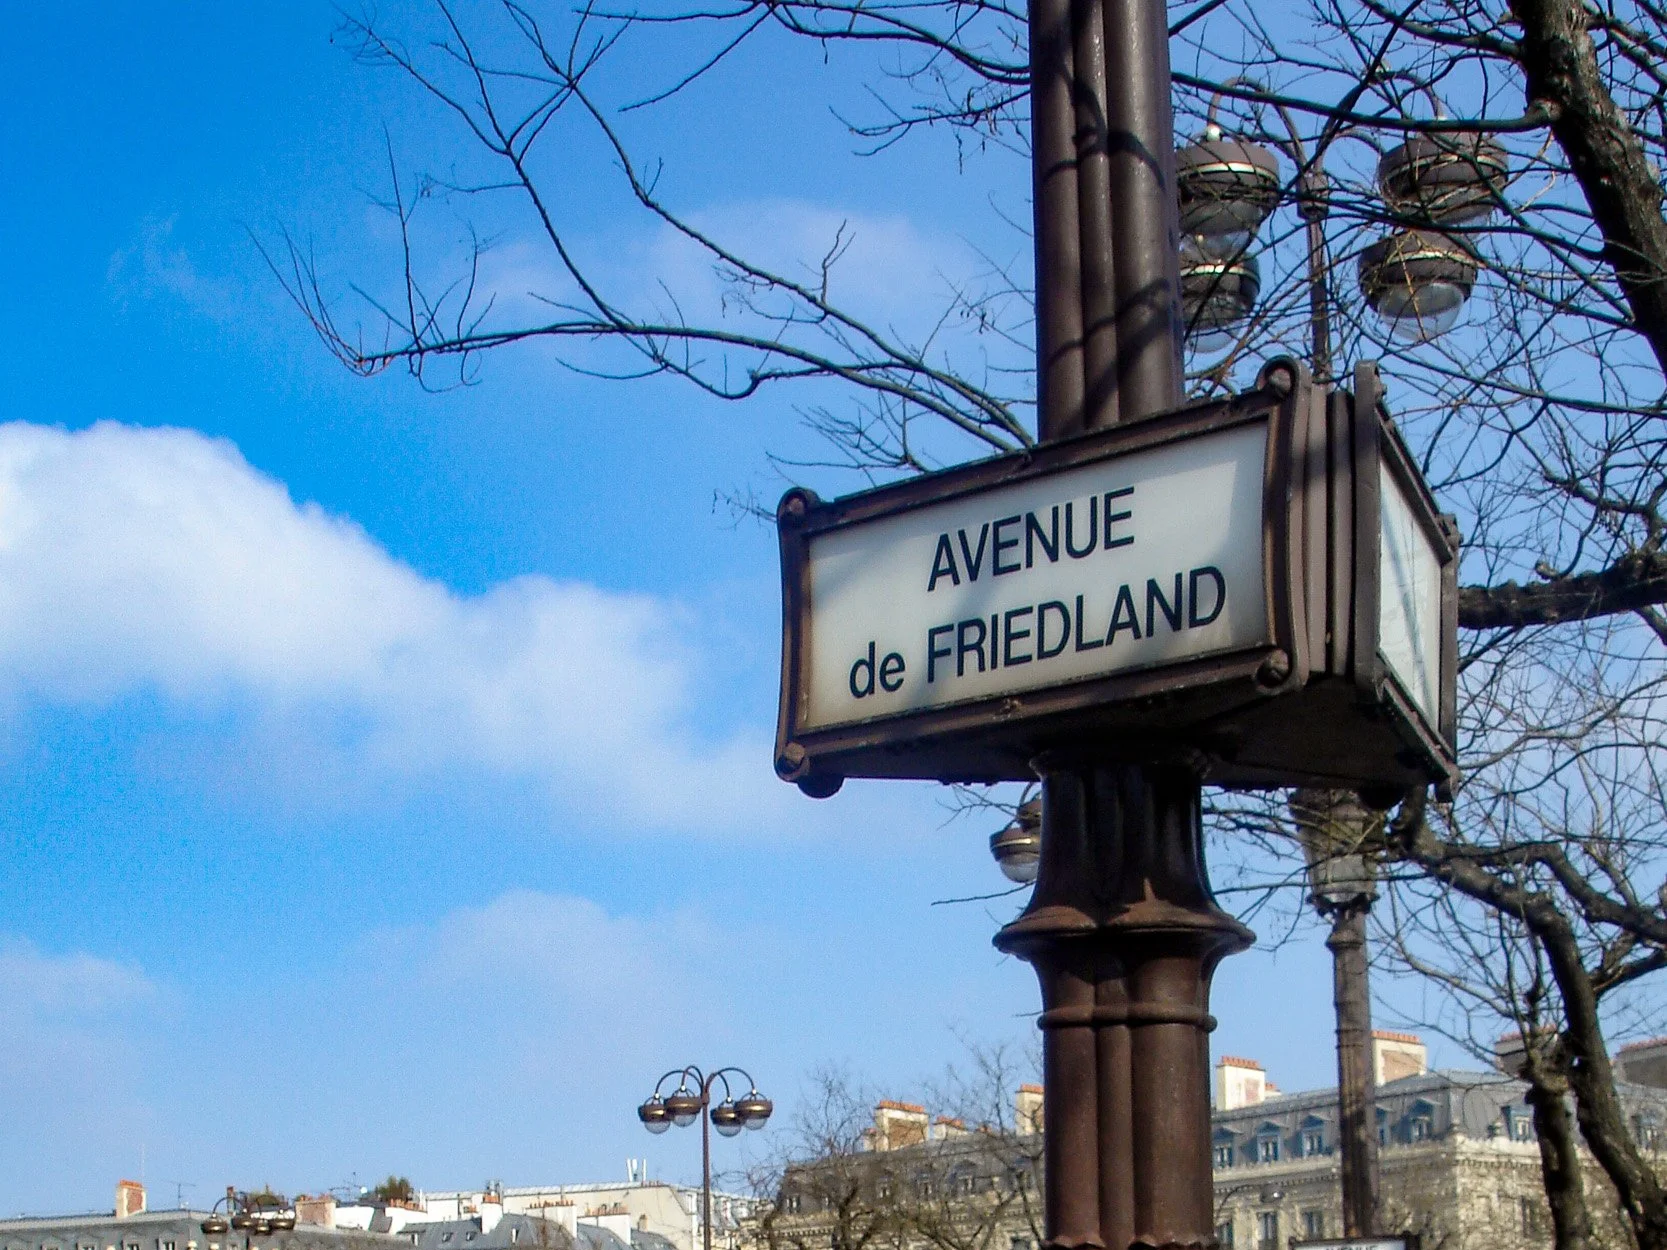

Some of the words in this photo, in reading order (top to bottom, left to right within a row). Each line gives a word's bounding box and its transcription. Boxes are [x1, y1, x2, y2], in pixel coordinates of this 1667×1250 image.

[927, 486, 1135, 592] AVENUE
[849, 640, 906, 698] de
[926, 565, 1226, 684] FRIEDLAND
